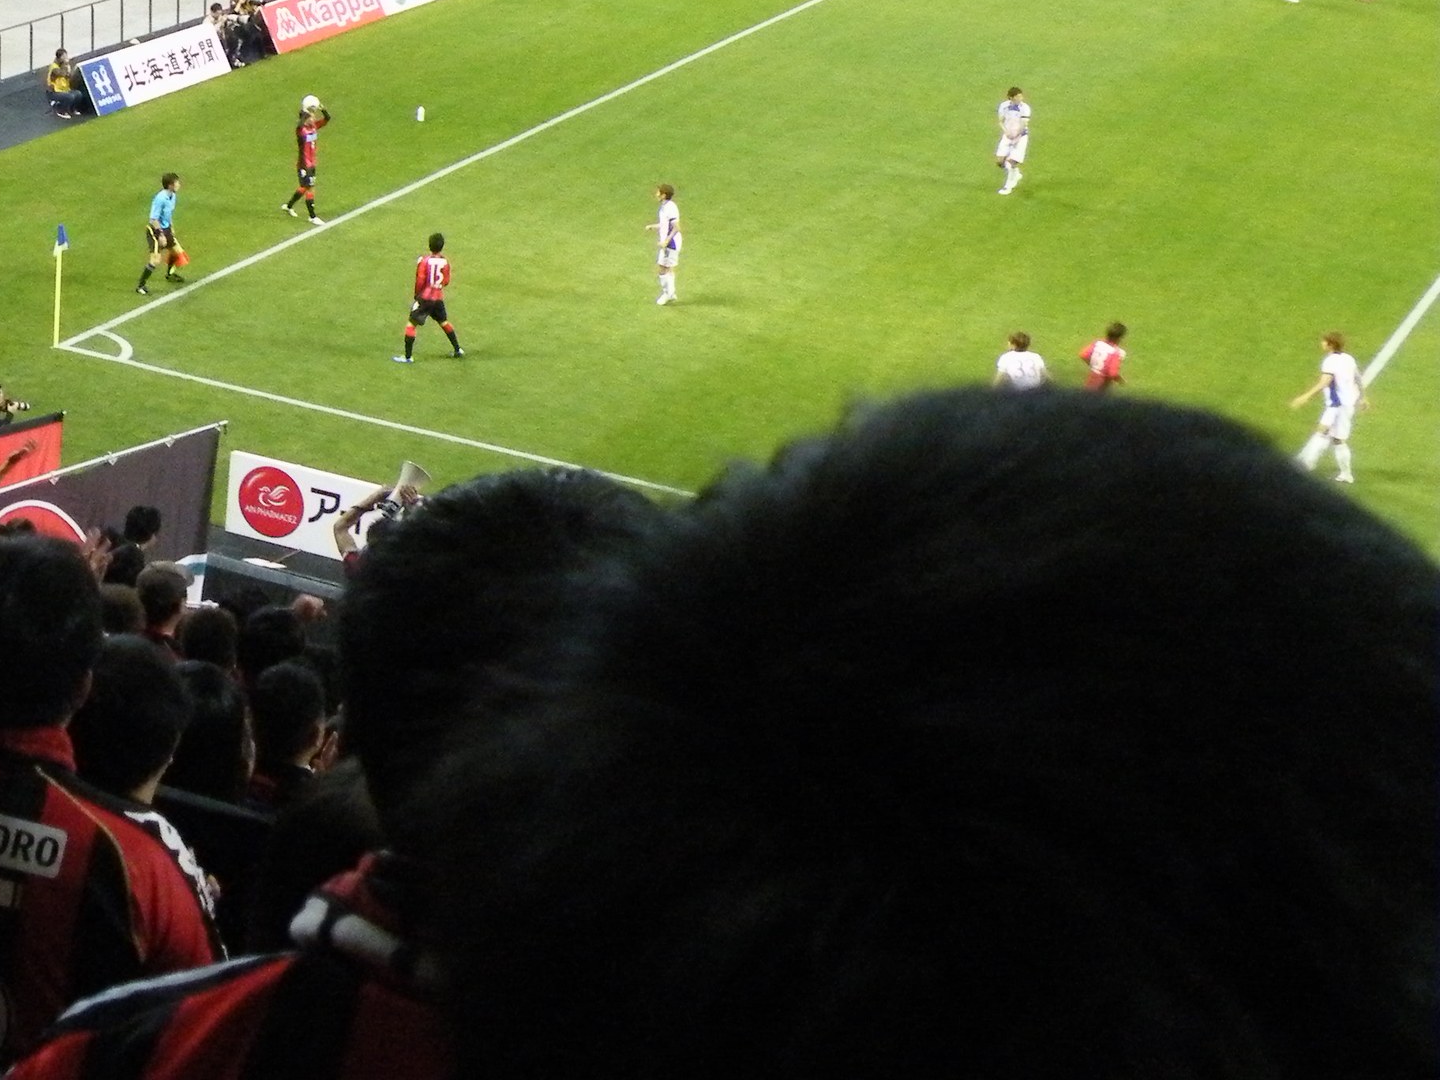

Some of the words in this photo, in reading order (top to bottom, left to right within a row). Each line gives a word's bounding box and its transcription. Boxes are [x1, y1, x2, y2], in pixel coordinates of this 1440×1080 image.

[124, 38, 221, 92] 北海道新聞
